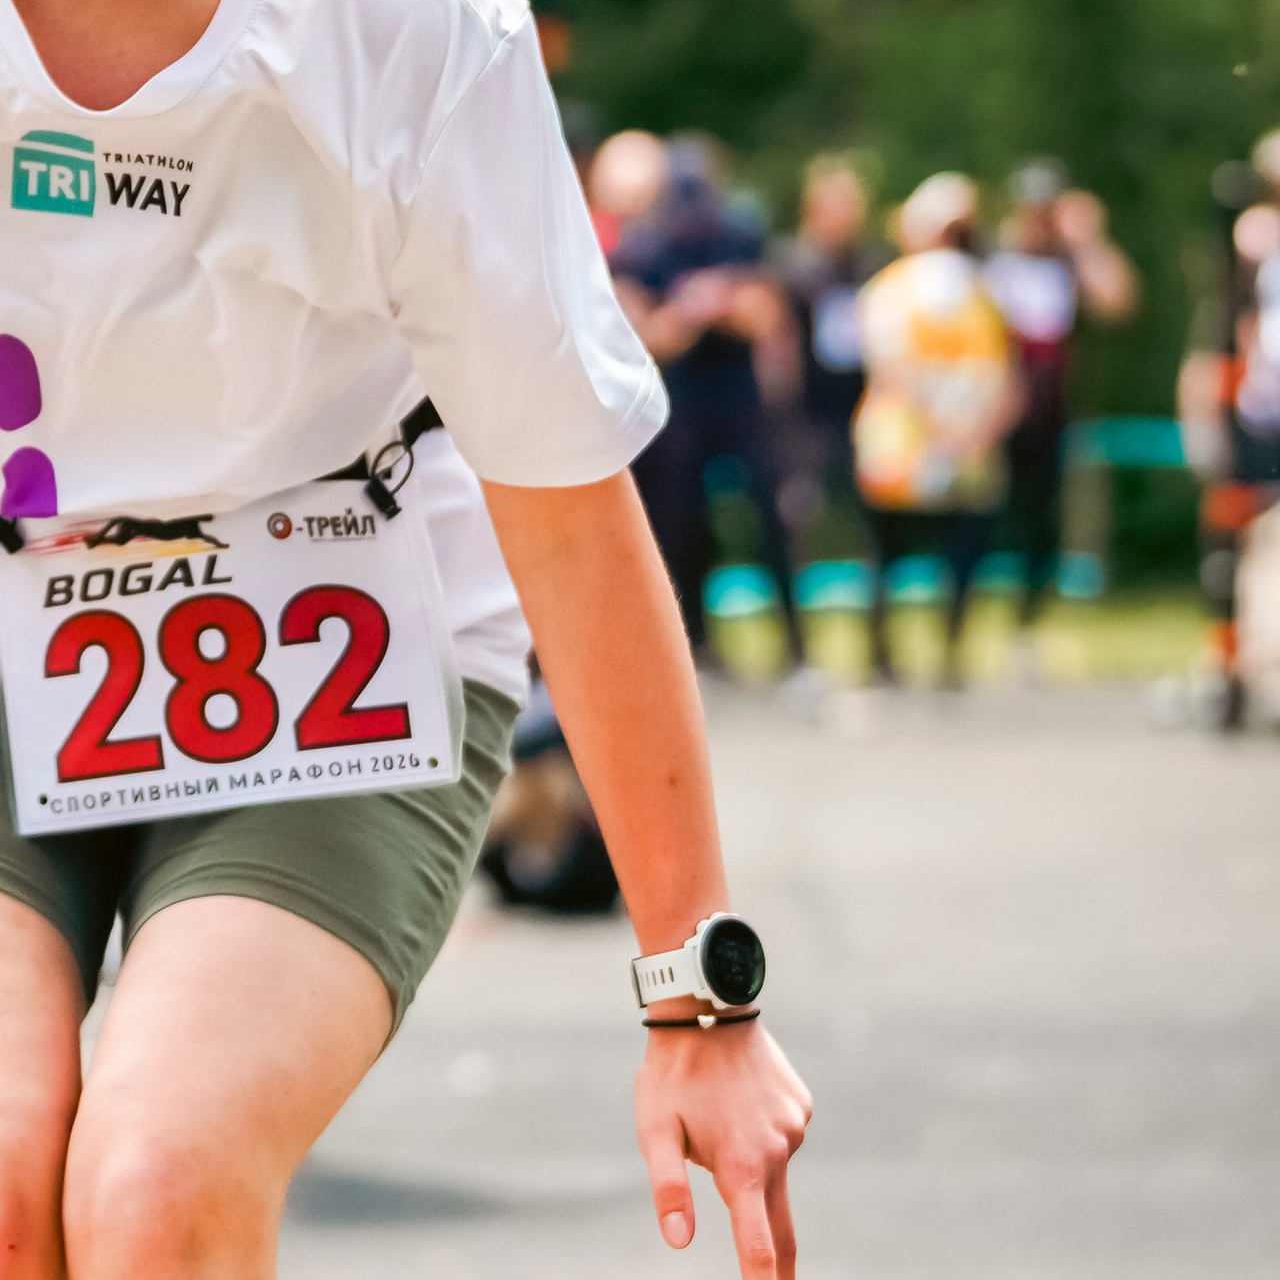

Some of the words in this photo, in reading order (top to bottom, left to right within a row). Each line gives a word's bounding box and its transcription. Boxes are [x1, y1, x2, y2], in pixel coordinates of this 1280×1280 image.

[19, 160, 90, 202] TRI
[104, 172, 191, 217] WAY
[102, 152, 194, 173] TRIATHLON
[43, 554, 233, 608] BOGAL
[43, 583, 412, 783] 282
[50, 775, 219, 814] СПОРТИВНЫЙ
[228, 757, 362, 790] МАРАФОН
[370, 752, 420, 773] 2026
